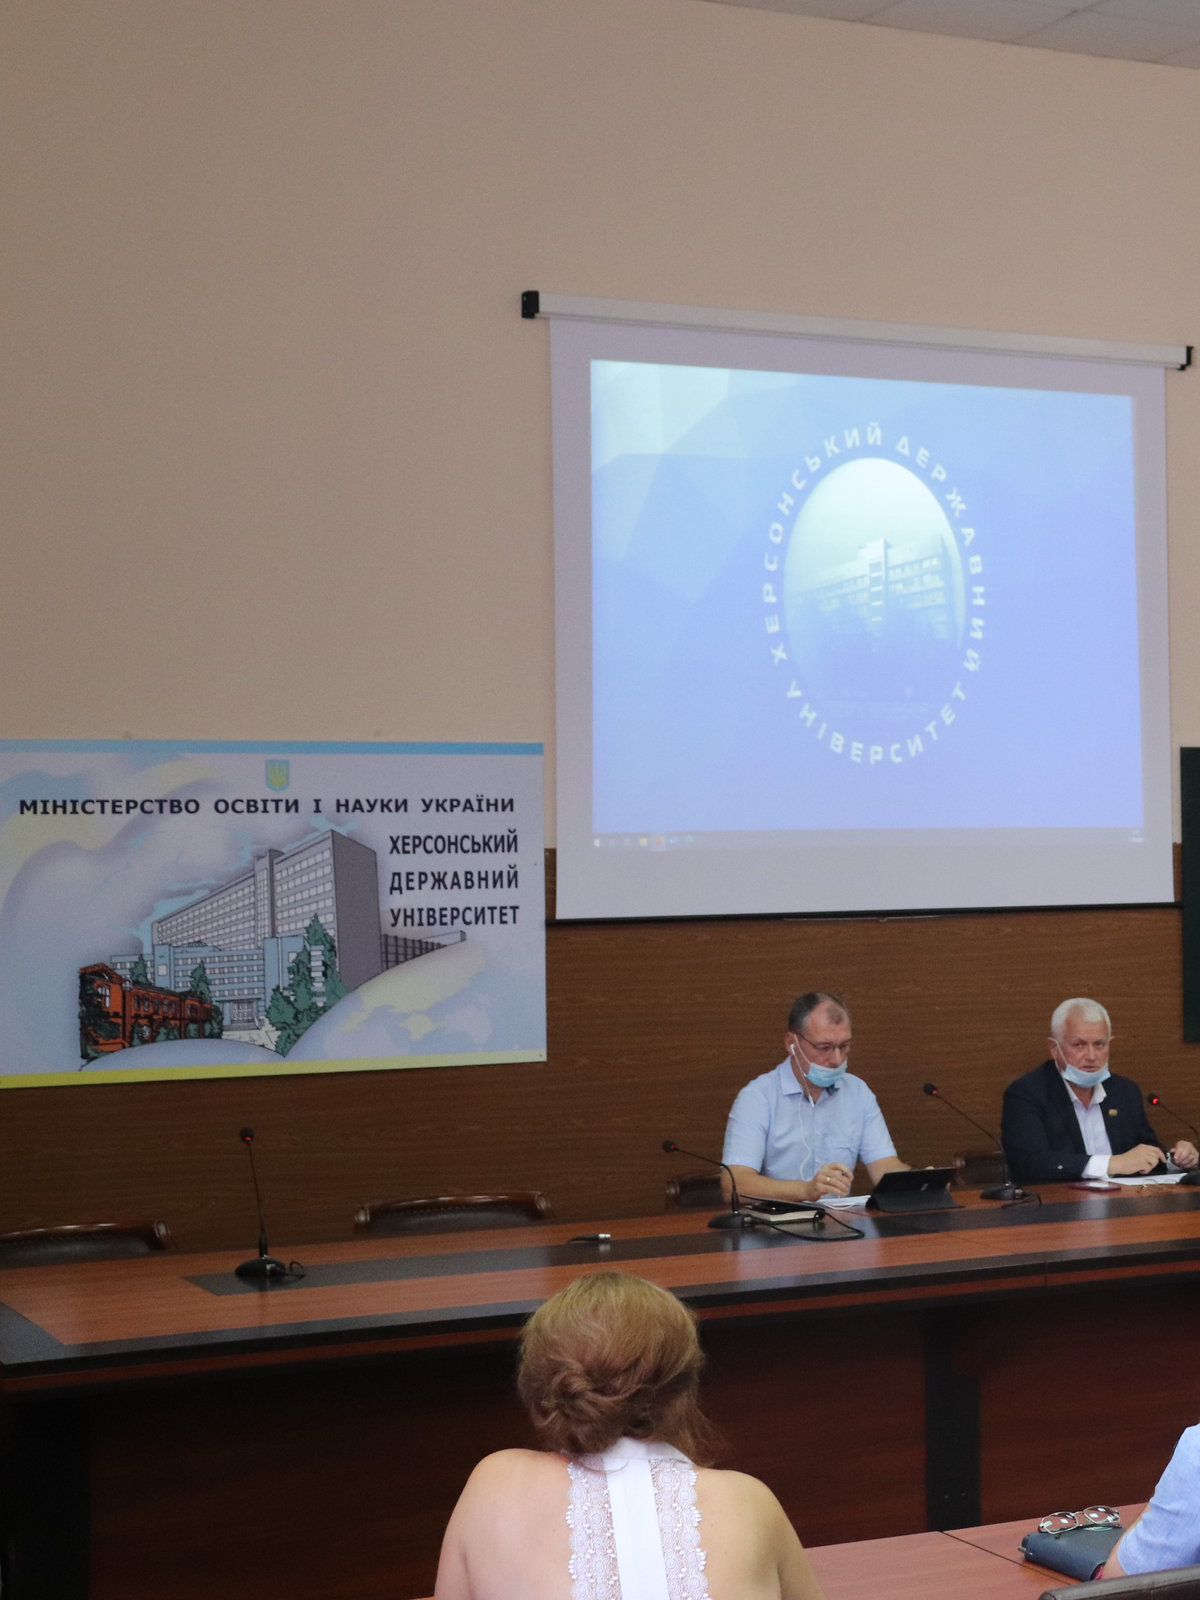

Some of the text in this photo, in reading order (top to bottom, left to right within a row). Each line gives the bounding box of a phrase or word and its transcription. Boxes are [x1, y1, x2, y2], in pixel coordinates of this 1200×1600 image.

[763, 422, 985, 672] ХЕРСОНСЬКИЙ ДЕРЖАВНИЙ
[786, 681, 967, 764] УНІВЕРСИТЕТ
[19, 795, 514, 815] МІНІСТЕРСТВО ОСВІТИ І НАУКИ УКРАЇНИ
[389, 829, 518, 855] ХЕРСОНСЬКИЙ
[389, 864, 518, 894] ДЕРЖАВНИЙ
[390, 906, 519, 927] УНІВЕРСИТЕТ
